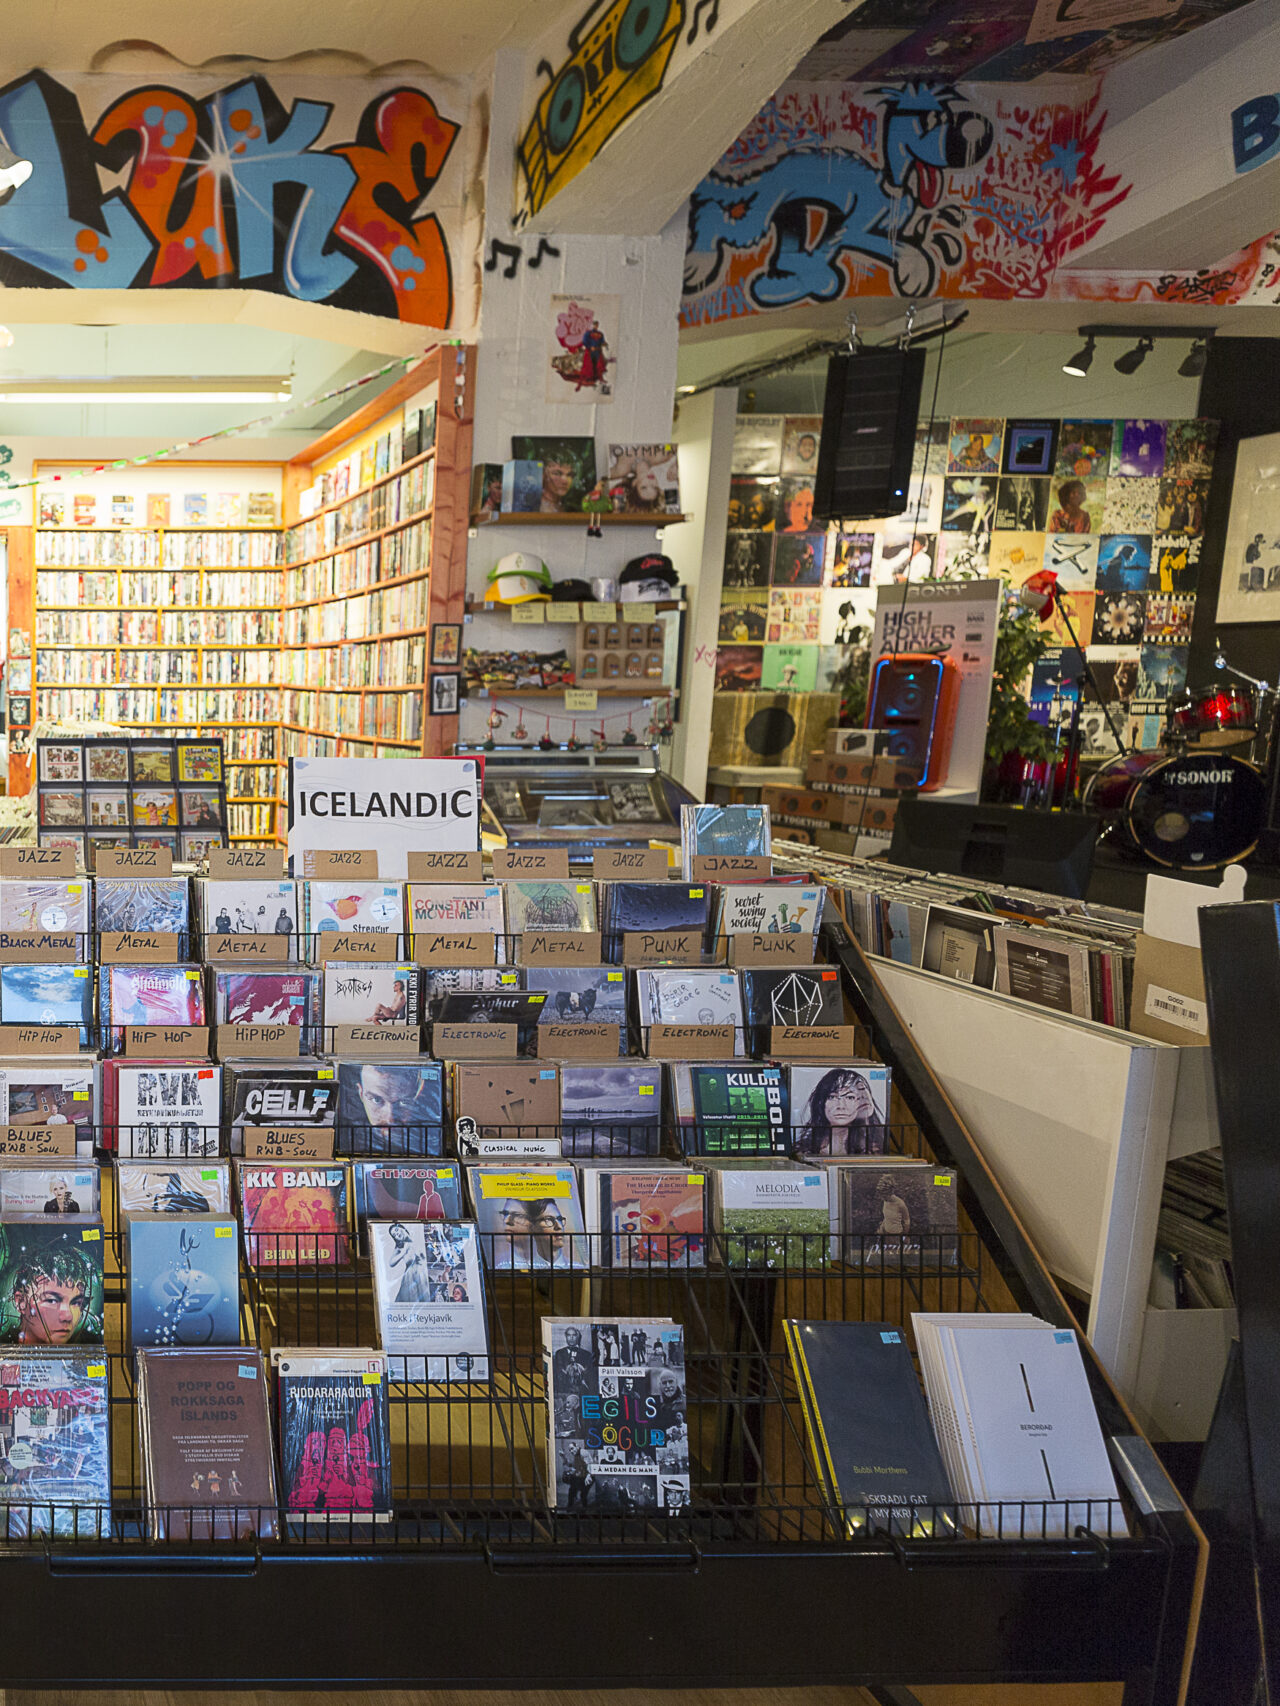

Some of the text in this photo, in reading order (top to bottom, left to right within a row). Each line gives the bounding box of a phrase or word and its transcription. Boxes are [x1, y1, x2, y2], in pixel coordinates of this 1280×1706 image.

[884, 611, 932, 627] HIGH
[882, 625, 956, 641] POWER
[1177, 769, 1233, 785] SONOR
[300, 789, 473, 818] ICELANDIC
[18, 850, 62, 863] JAZZ
[115, 851, 157, 866] JAZZ
[226, 852, 266, 866] JAZZ
[426, 853, 468, 868] JAZZ
[507, 852, 546, 868] JAZZ
[612, 852, 645, 867] JAZZ
[704, 858, 757, 870] JAZZ
[415, 900, 486, 910] CONSTANT
[737, 906, 767, 920] swing
[0, 934, 76, 948] BLACK METAL
[116, 934, 160, 951] METAL
[217, 938, 267, 953] METAL
[332, 937, 377, 953] METAL
[429, 936, 477, 952] METAL
[530, 937, 585, 953] METAL
[641, 935, 690, 953] PUNK
[752, 937, 796, 953] PUNK
[409, 972, 418, 1012] EKKI FYRIR
[164, 1031, 193, 1043] HOP
[261, 1028, 286, 1041] HOP
[138, 1073, 203, 1106] RVK
[7, 1129, 52, 1141] BLUES
[266, 1131, 305, 1145] BLUES
[246, 1173, 278, 1189] KK
[755, 1184, 801, 1193] MELODIA
[387, 1314, 408, 1323] Rokk
[177, 1381, 236, 1391] POPP OG
[171, 1395, 245, 1406] ROKKSAGA
[582, 1395, 657, 1423] EGILS
[586, 1423, 665, 1450] SÖGUR
[910, 1494, 928, 1505] GAT
